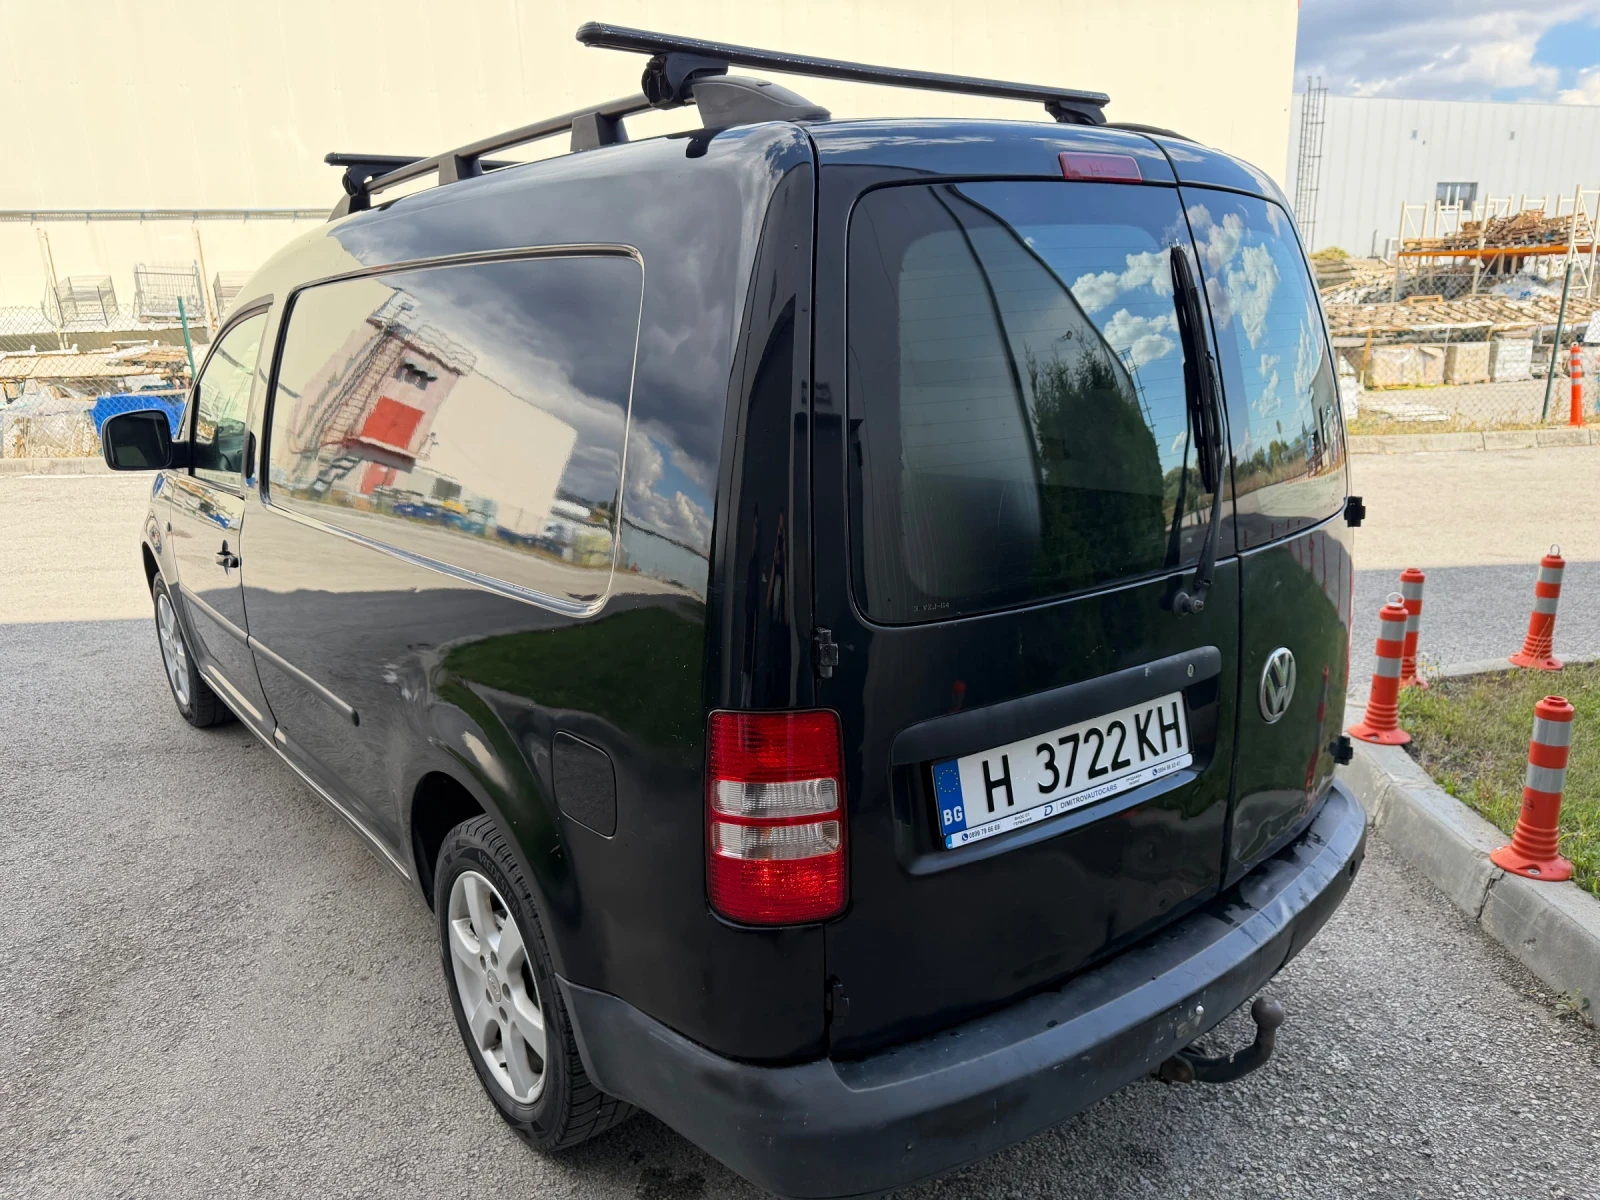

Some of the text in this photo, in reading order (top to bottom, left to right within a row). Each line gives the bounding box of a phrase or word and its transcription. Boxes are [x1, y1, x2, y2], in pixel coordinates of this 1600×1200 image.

[981, 753, 1015, 813] H
[1060, 784, 1118, 809] DIMITROVAUTOCARS
[943, 805, 963, 826] BG
[478, 851, 521, 917] VREDESTEIN
